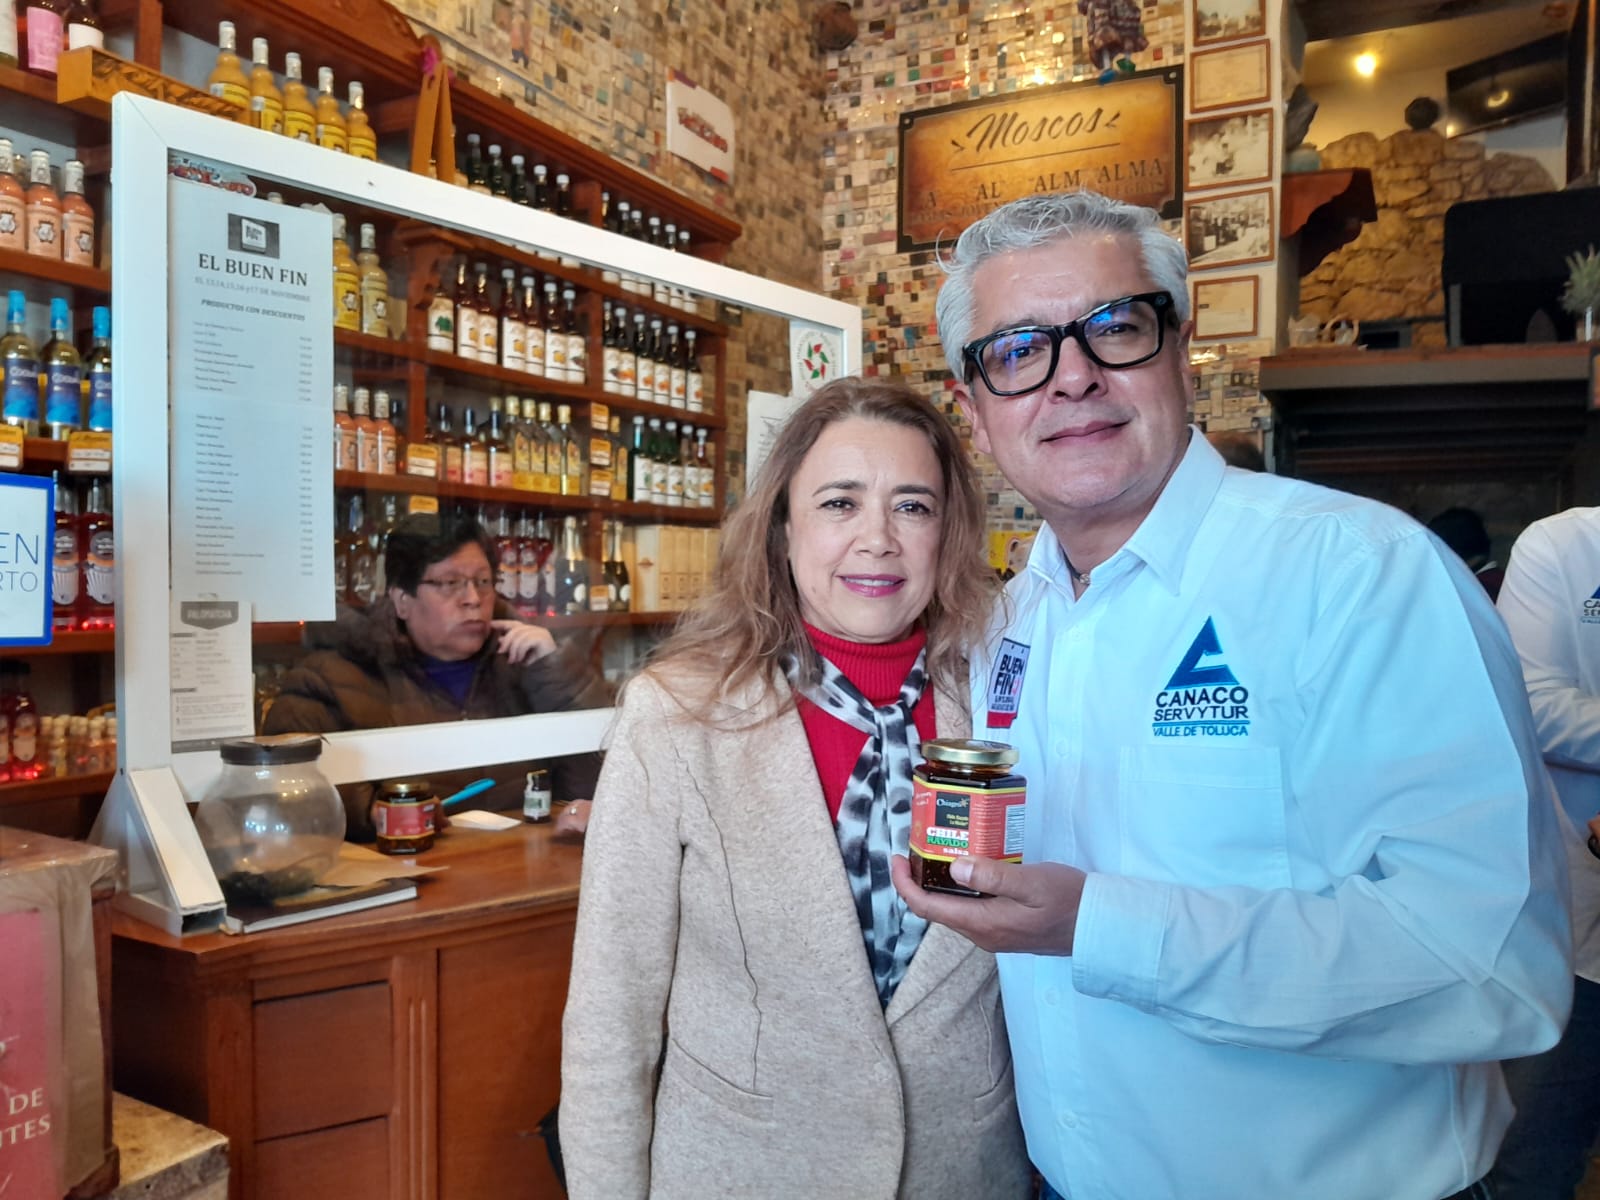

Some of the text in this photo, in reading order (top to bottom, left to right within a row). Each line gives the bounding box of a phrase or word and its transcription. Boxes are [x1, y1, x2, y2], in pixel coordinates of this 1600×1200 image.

[966, 108, 1103, 152] Moscos
[975, 182, 1001, 201] AL
[1034, 169, 1081, 193] ALM
[1097, 158, 1164, 183] ALMA
[199, 253, 308, 287] EL BUEN FIN
[201, 299, 306, 321] PRODUCTOS CON DESCUENTOS
[1000, 653, 1025, 676] BUEN
[993, 671, 1016, 696] FIN
[1155, 686, 1249, 708] CANACO
[1153, 705, 1249, 721] SERVYTUR
[1153, 725, 1249, 737] VALLE DE TOLUCA
[926, 827, 970, 841] CHILE
[9, 1087, 43, 1116] DE
[0, 1114, 51, 1149] TES
